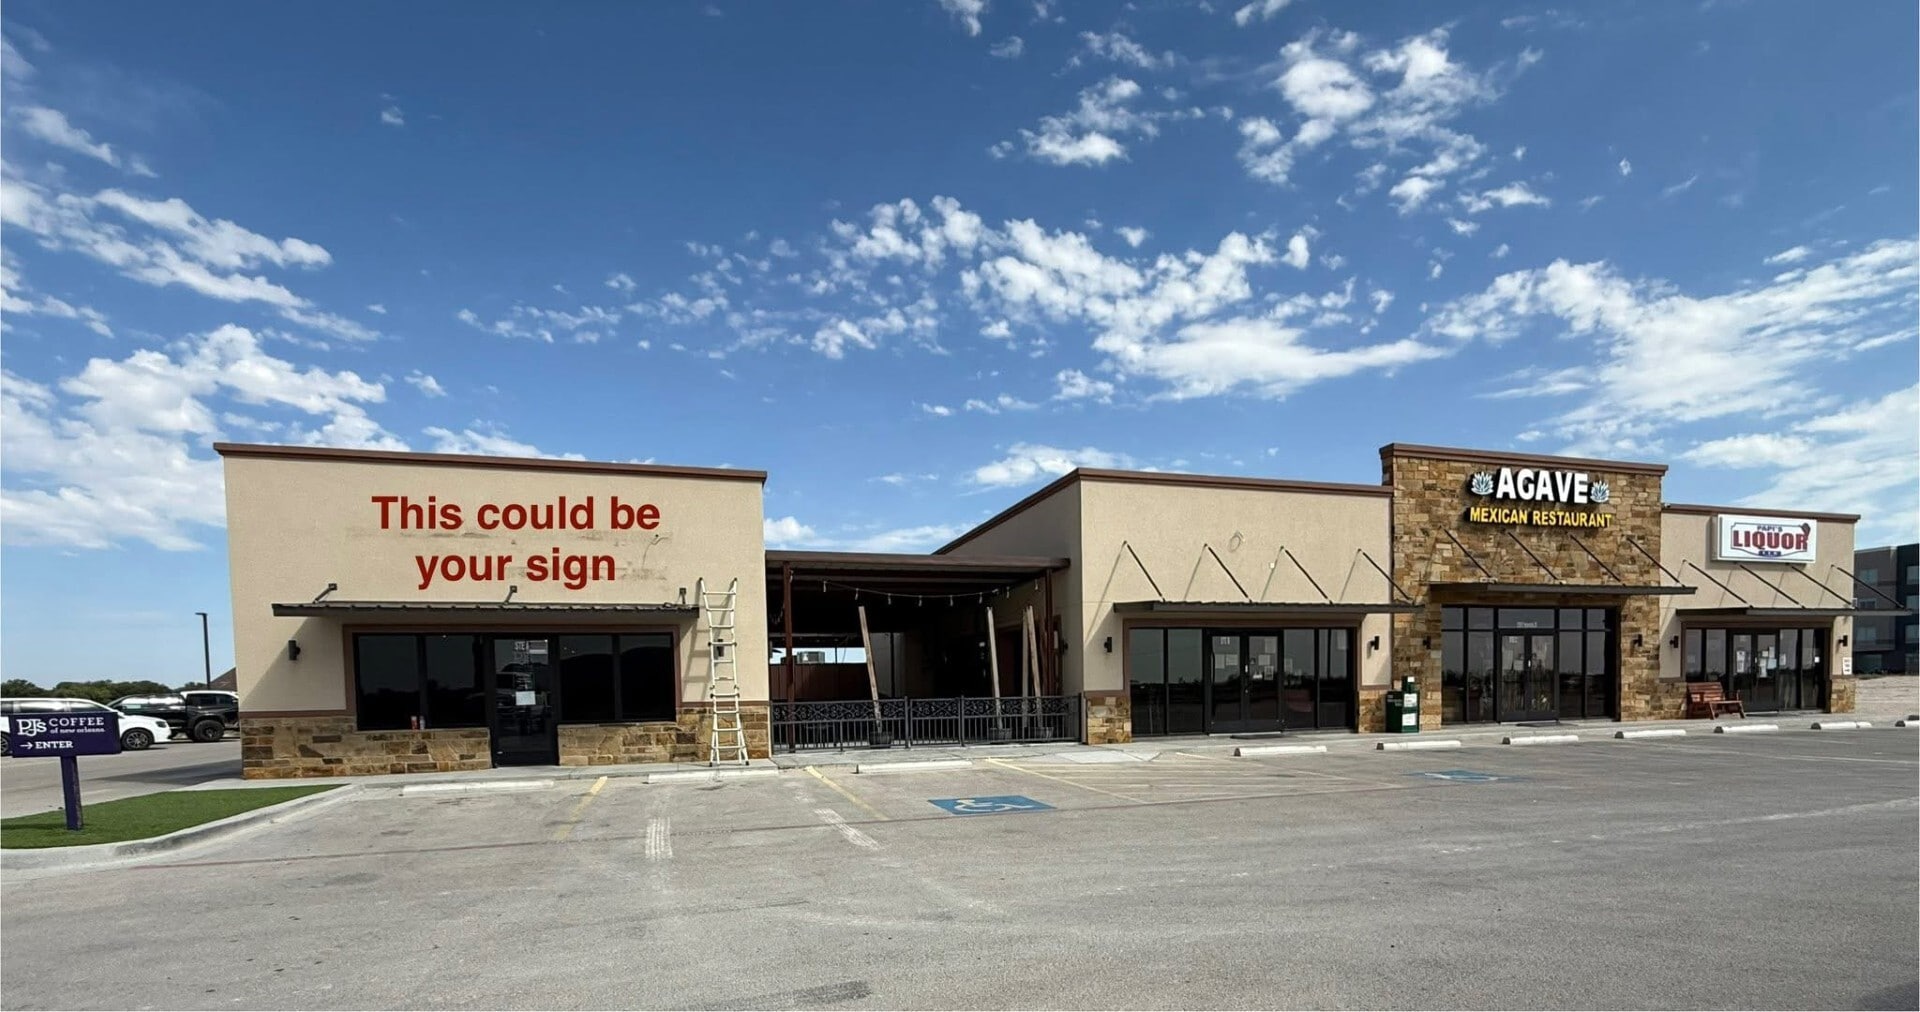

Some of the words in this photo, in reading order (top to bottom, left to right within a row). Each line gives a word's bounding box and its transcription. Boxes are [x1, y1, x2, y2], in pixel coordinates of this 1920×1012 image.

[1496, 467, 1588, 504] AGAVE
[1470, 507, 1528, 524] MEXICAN
[1532, 510, 1612, 528] RESTAURANT
[1733, 530, 1808, 550] LIQUOR
[49, 717, 104, 727] COFFEE
[35, 741, 74, 749] ENTER
